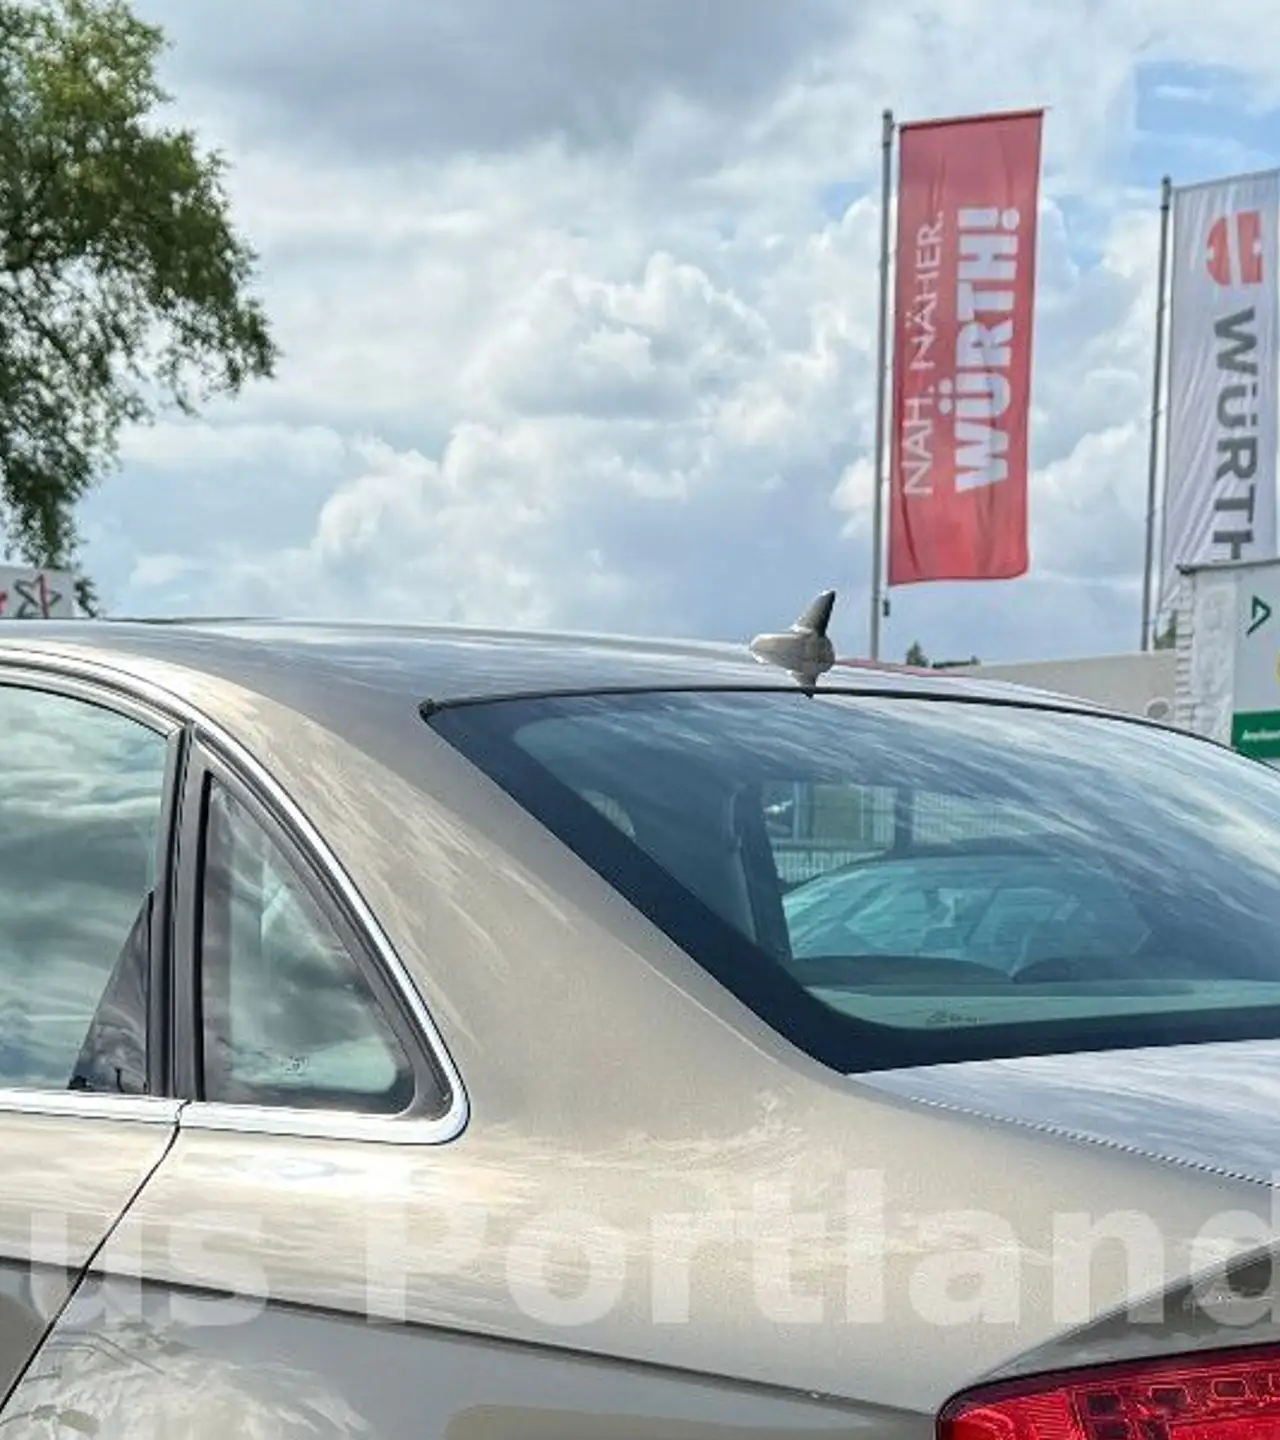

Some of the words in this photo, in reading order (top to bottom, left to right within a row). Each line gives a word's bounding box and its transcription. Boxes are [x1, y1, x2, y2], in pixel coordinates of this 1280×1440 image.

[904, 211, 943, 371] NÄHER.
[938, 208, 1020, 493] WÜRTH!
[902, 384, 935, 495] NAH.
